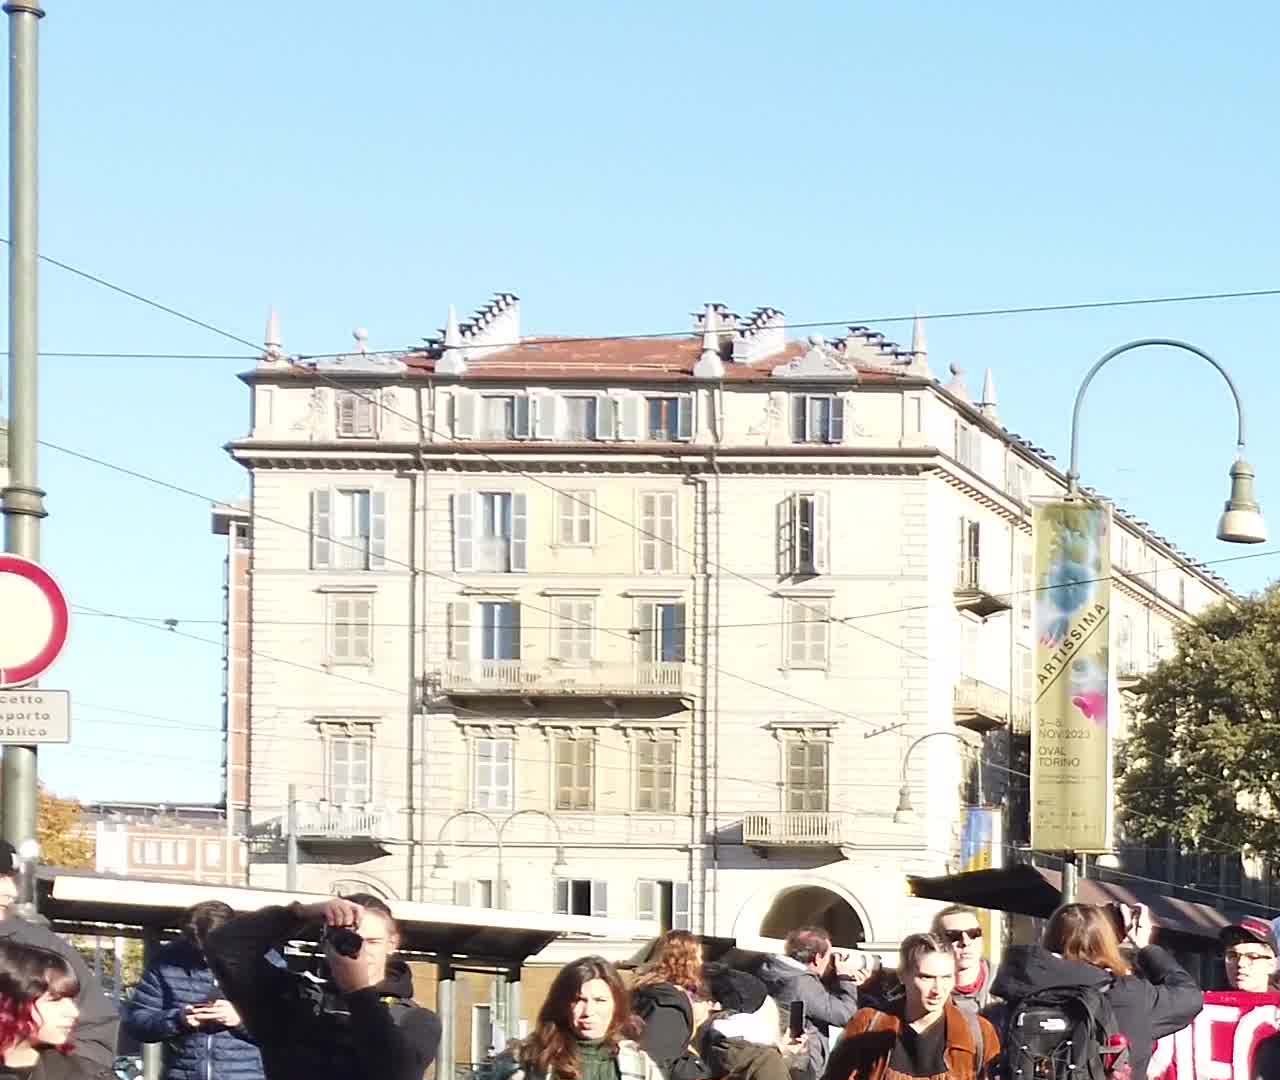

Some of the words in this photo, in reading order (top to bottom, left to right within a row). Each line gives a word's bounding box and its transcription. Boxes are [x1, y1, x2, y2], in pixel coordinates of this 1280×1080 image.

[1037, 603, 1106, 685] ARTISSIMA
[1039, 729, 1061, 739] NOV
[1039, 746, 1067, 756] OVAL
[1039, 757, 1081, 767] TORINO
